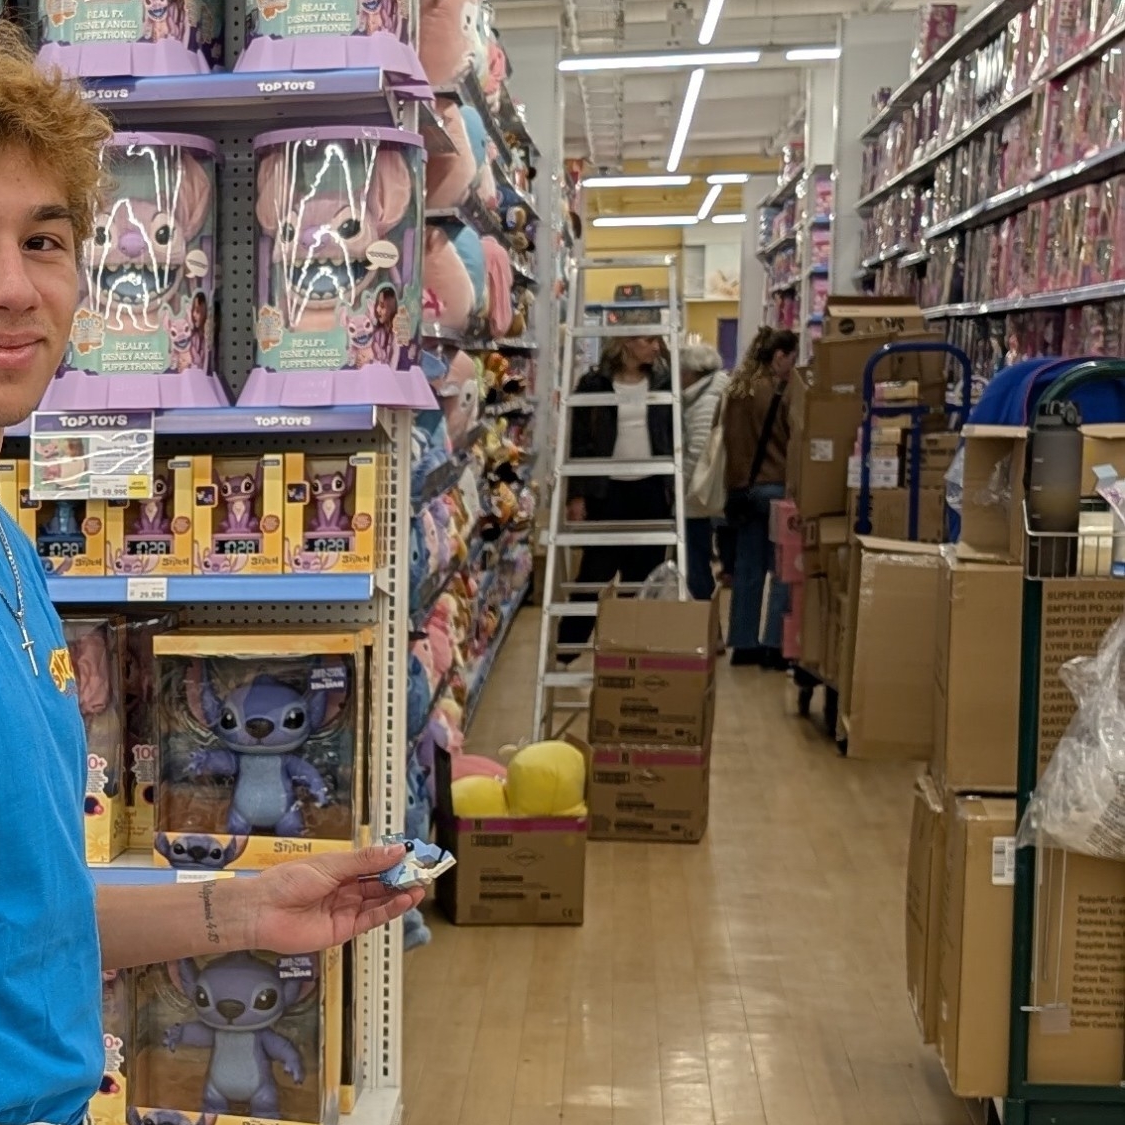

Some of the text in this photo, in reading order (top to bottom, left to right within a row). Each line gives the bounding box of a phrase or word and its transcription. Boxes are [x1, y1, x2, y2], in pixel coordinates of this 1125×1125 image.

[319, 13, 351, 21] ANGEL
[75, 20, 137, 30] DISNEY ANGEL
[75, 31, 137, 40] PUPPETRONIC
[257, 81, 315, 92] TOP TOYS
[98, 89, 129, 98] TOYS
[135, 352, 163, 360] ANGEL
[310, 349, 341, 357] ANGEL
[59, 415, 128, 427] TOP TOYS
[255, 416, 312, 426] TOP TOYS
[1047, 591, 1094, 600] SUPPLIER
[1046, 604, 1087, 613] SMYTHS
[1088, 604, 1103, 613] PO
[1046, 616, 1087, 626] SMYTHS
[1045, 629, 1068, 638] SHIP
[1071, 629, 1084, 638] TO
